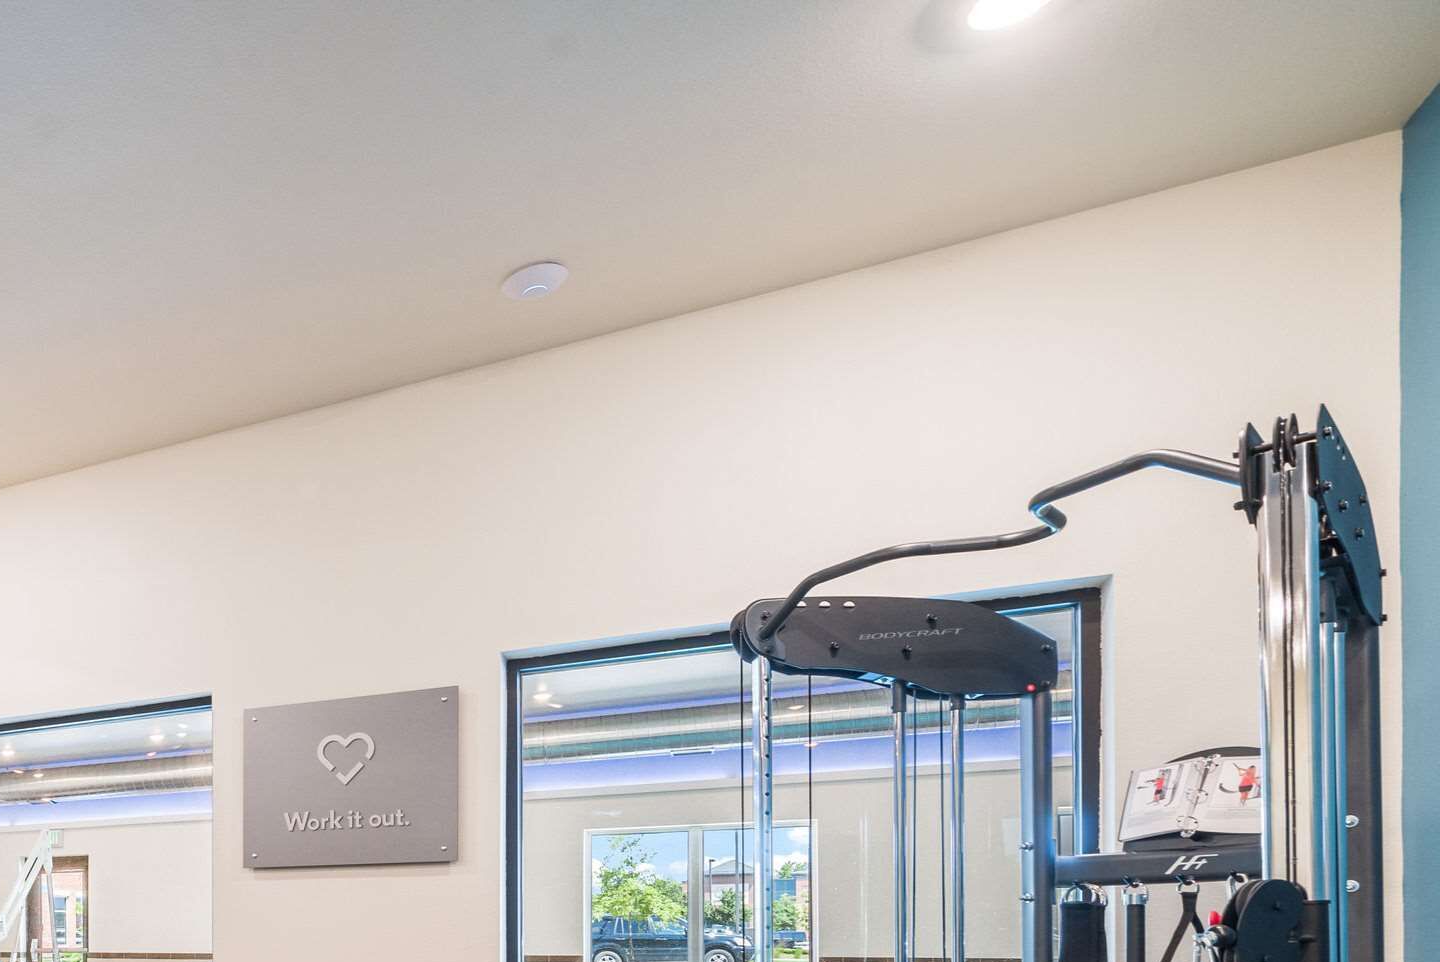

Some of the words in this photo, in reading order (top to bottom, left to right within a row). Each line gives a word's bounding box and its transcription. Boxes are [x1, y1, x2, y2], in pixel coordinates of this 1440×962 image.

[859, 627, 964, 641] BODYCRAFT
[283, 809, 344, 832] Work
[347, 809, 363, 829] it
[369, 808, 411, 828] out.
